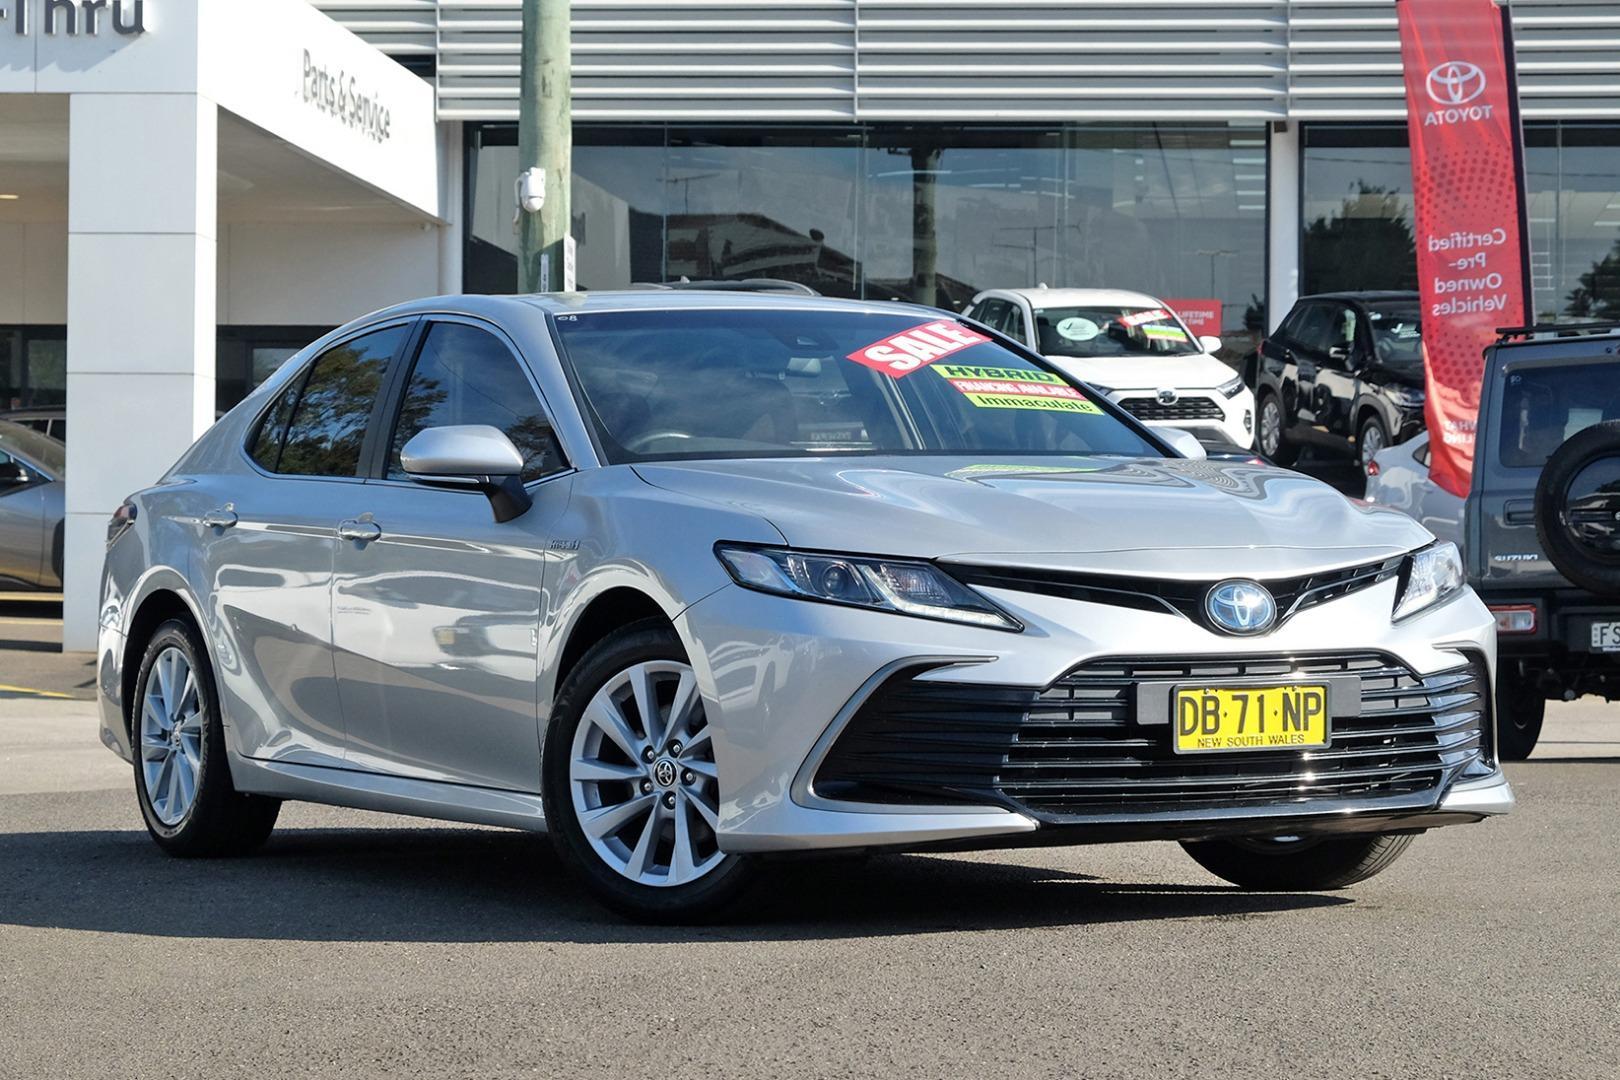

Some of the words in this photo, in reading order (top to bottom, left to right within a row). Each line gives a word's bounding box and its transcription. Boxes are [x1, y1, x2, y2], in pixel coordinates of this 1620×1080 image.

[303, 48, 335, 108] Parts
[338, 70, 346, 113] &
[349, 76, 390, 139] Service
[864, 322, 982, 370] SALE
[944, 366, 1055, 383] HYBRID
[976, 395, 1093, 412] Immaculate
[1197, 738, 1222, 748] NEW
[1226, 737, 1263, 747] SOUTH
[1268, 734, 1305, 744] WALES
